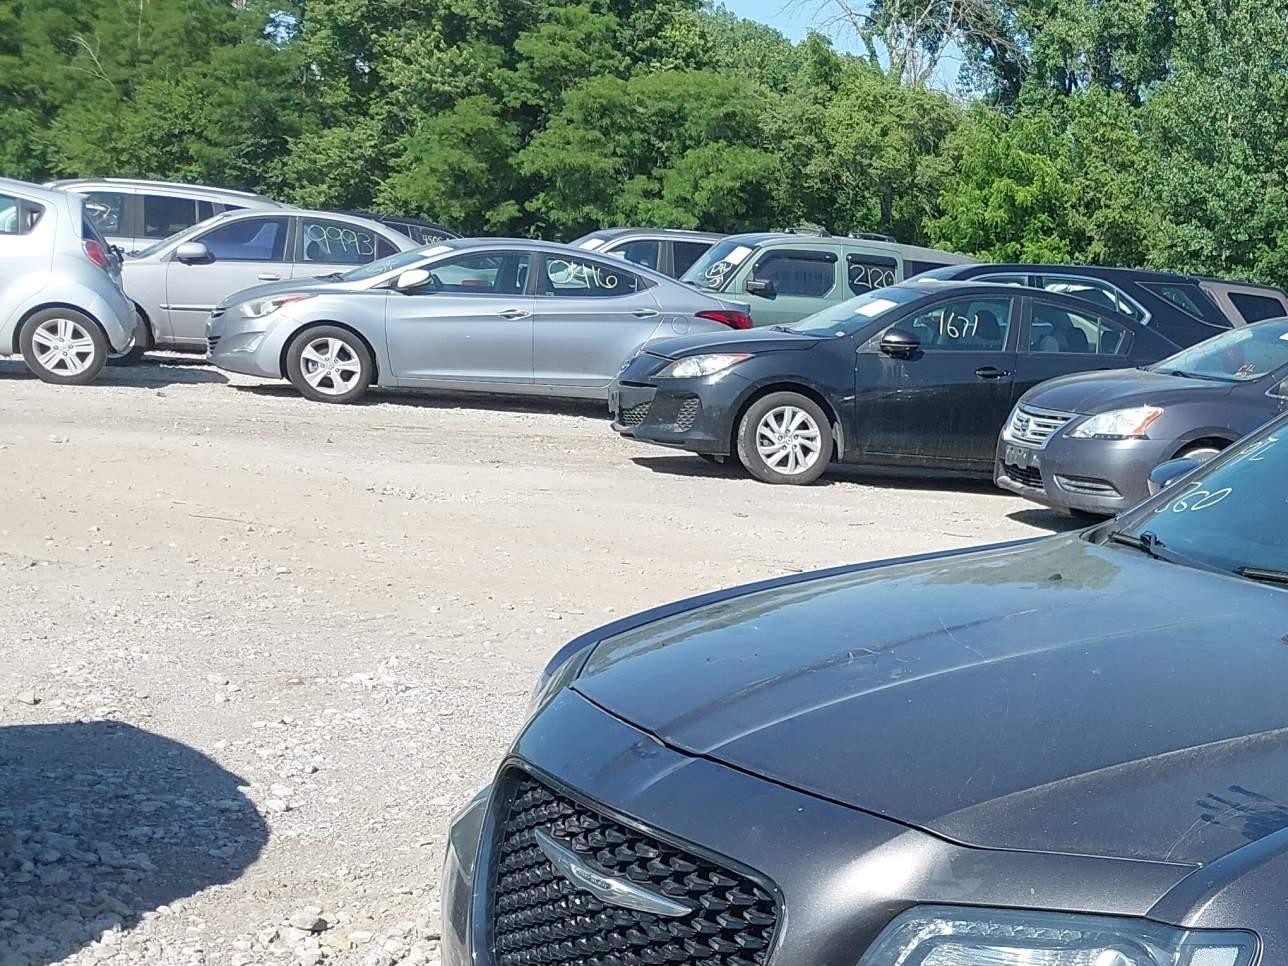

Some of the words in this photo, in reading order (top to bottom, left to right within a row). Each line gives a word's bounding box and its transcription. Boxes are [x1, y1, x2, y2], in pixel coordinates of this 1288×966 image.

[307, 224, 373, 256] 9993
[547, 259, 618, 289] 0416
[850, 264, 896, 290] 2120
[940, 311, 978, 338] 1671
[1155, 482, 1233, 513] 360
